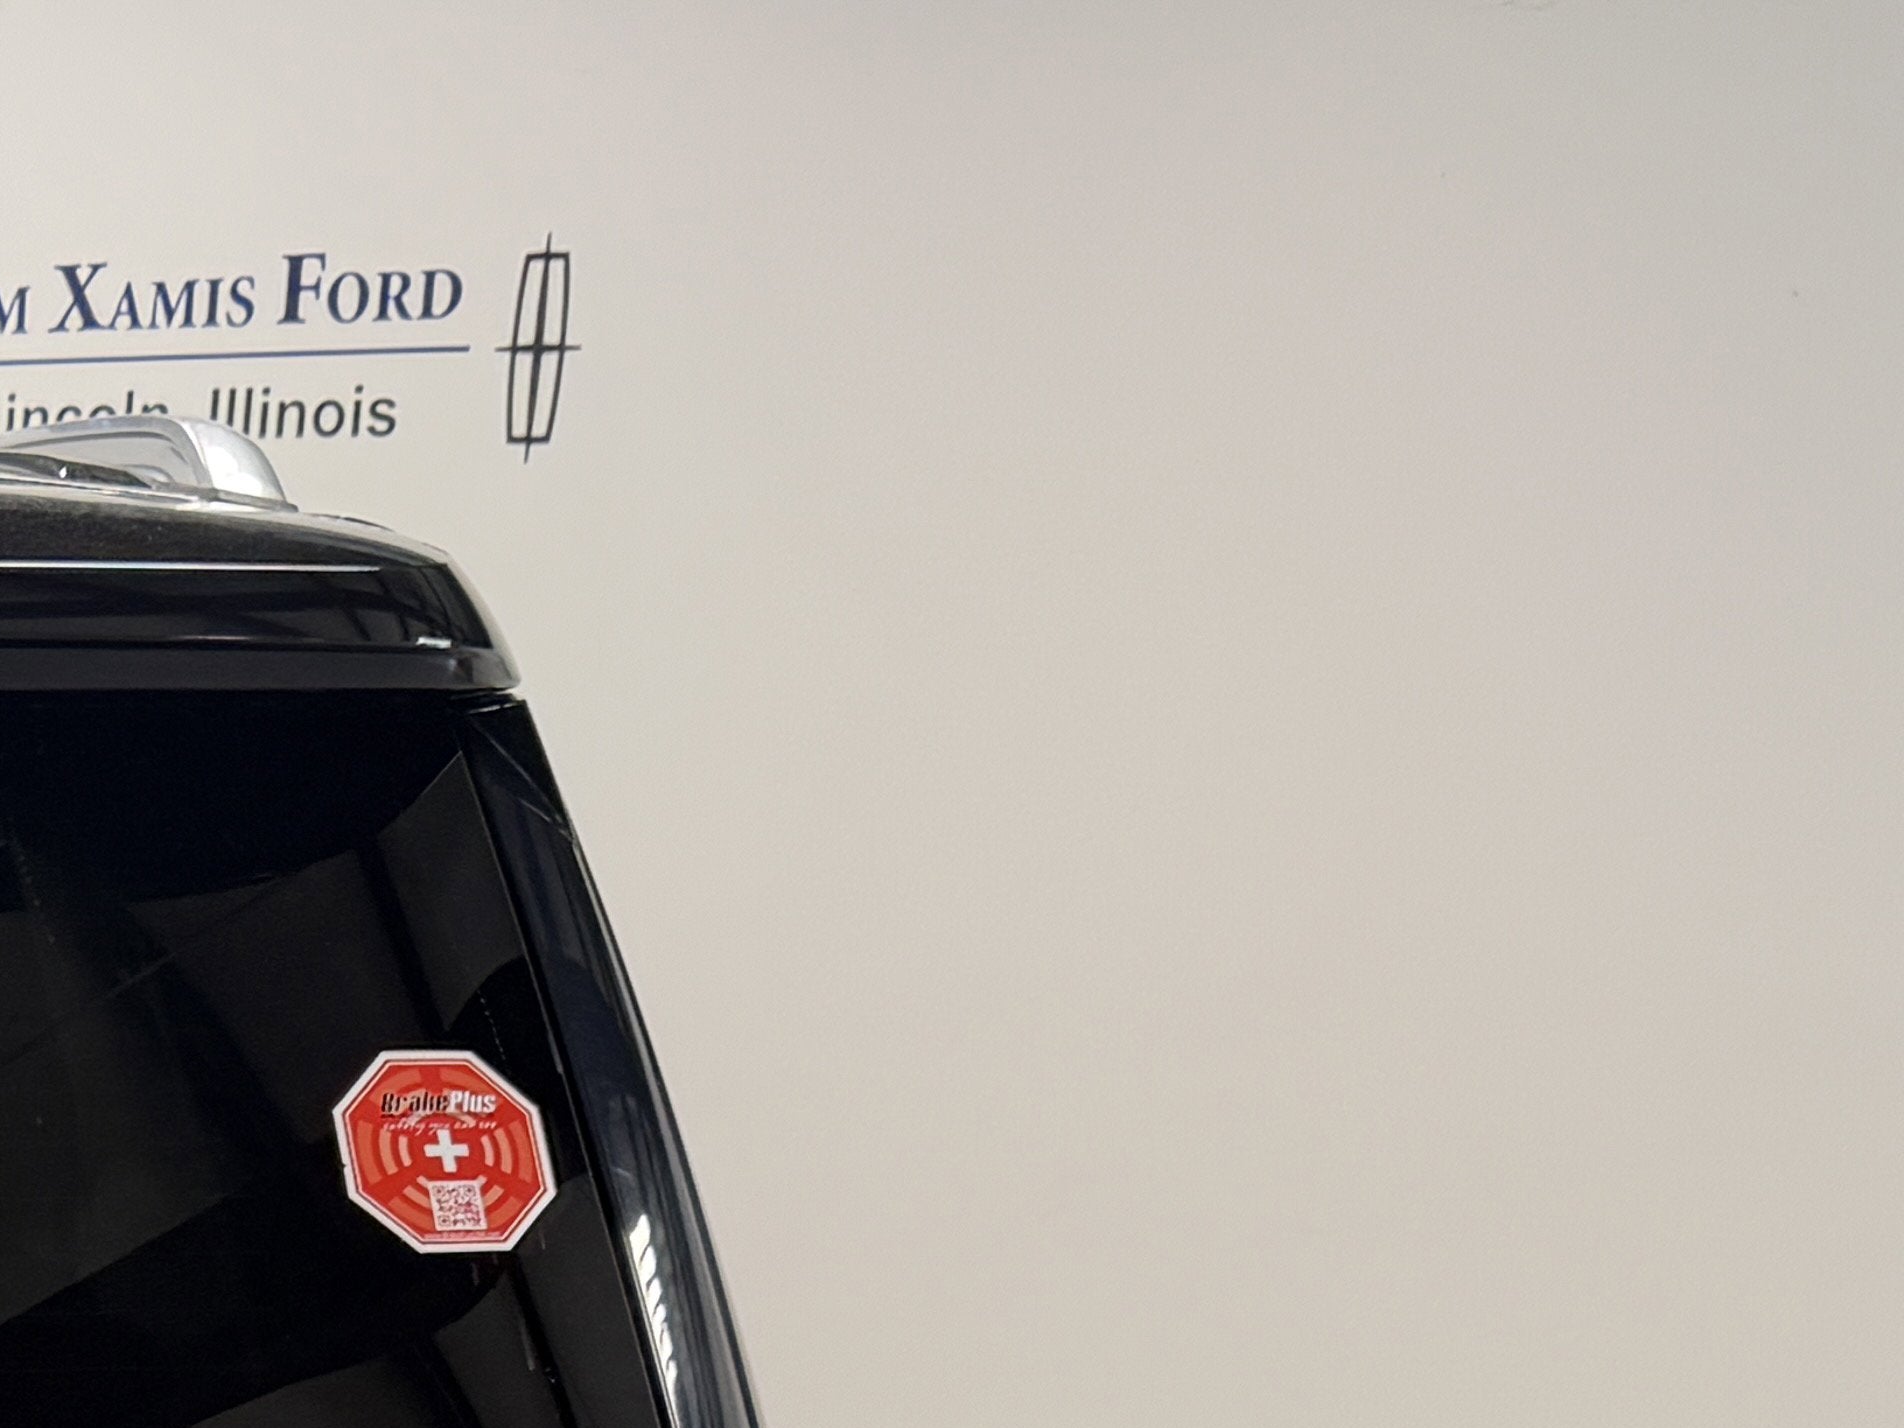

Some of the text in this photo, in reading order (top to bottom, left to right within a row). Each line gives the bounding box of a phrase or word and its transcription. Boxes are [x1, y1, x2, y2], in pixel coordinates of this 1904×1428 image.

[48, 262, 256, 334] XAMIS
[277, 252, 464, 325] FORD
[209, 384, 398, 439] Illinois
